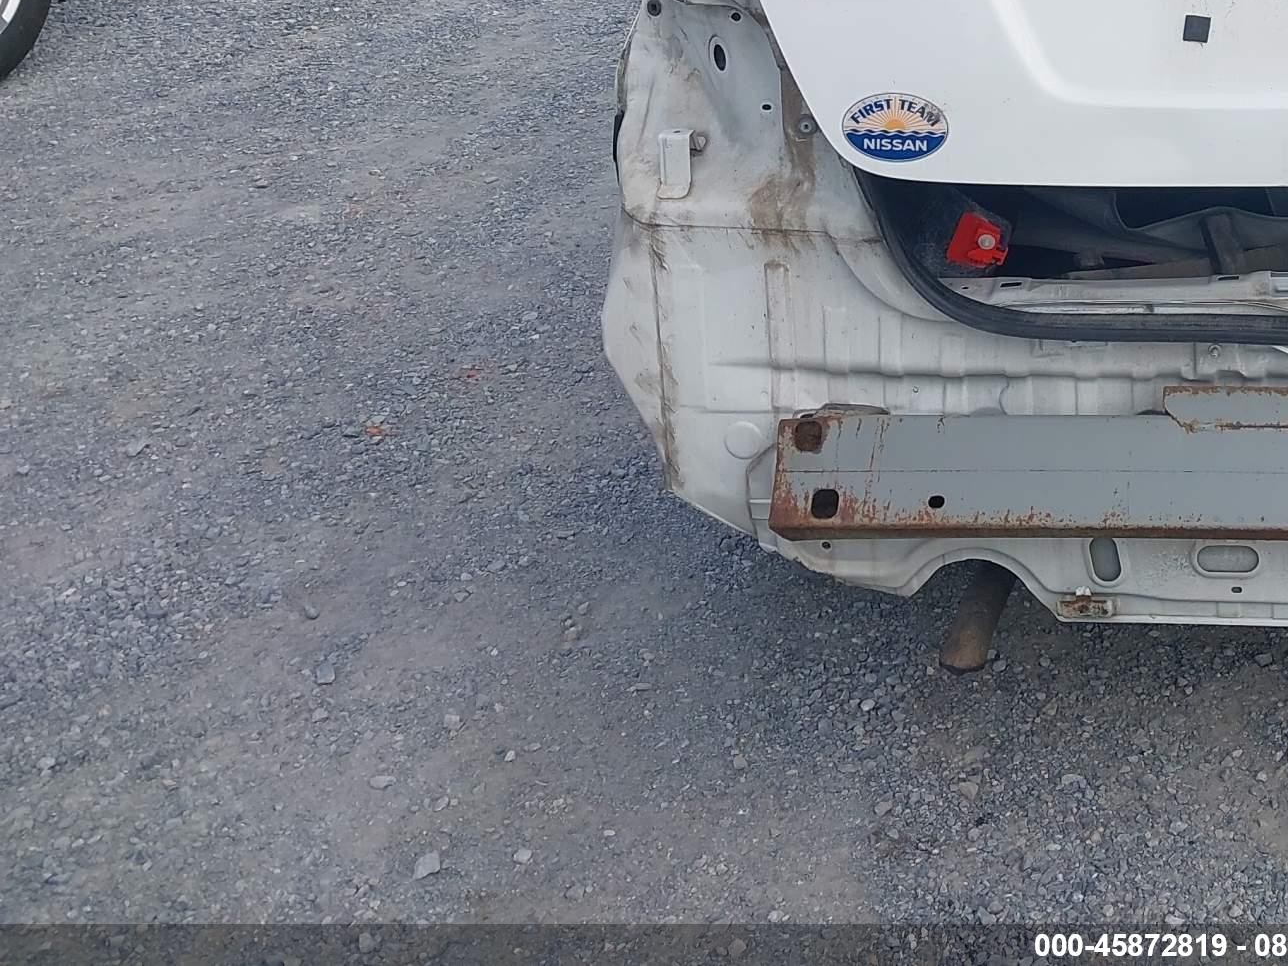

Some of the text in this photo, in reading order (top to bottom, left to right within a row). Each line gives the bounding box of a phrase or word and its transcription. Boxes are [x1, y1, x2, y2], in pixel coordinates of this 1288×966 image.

[850, 98, 941, 127] FIRST TEAM
[863, 137, 928, 152] NISSAN
